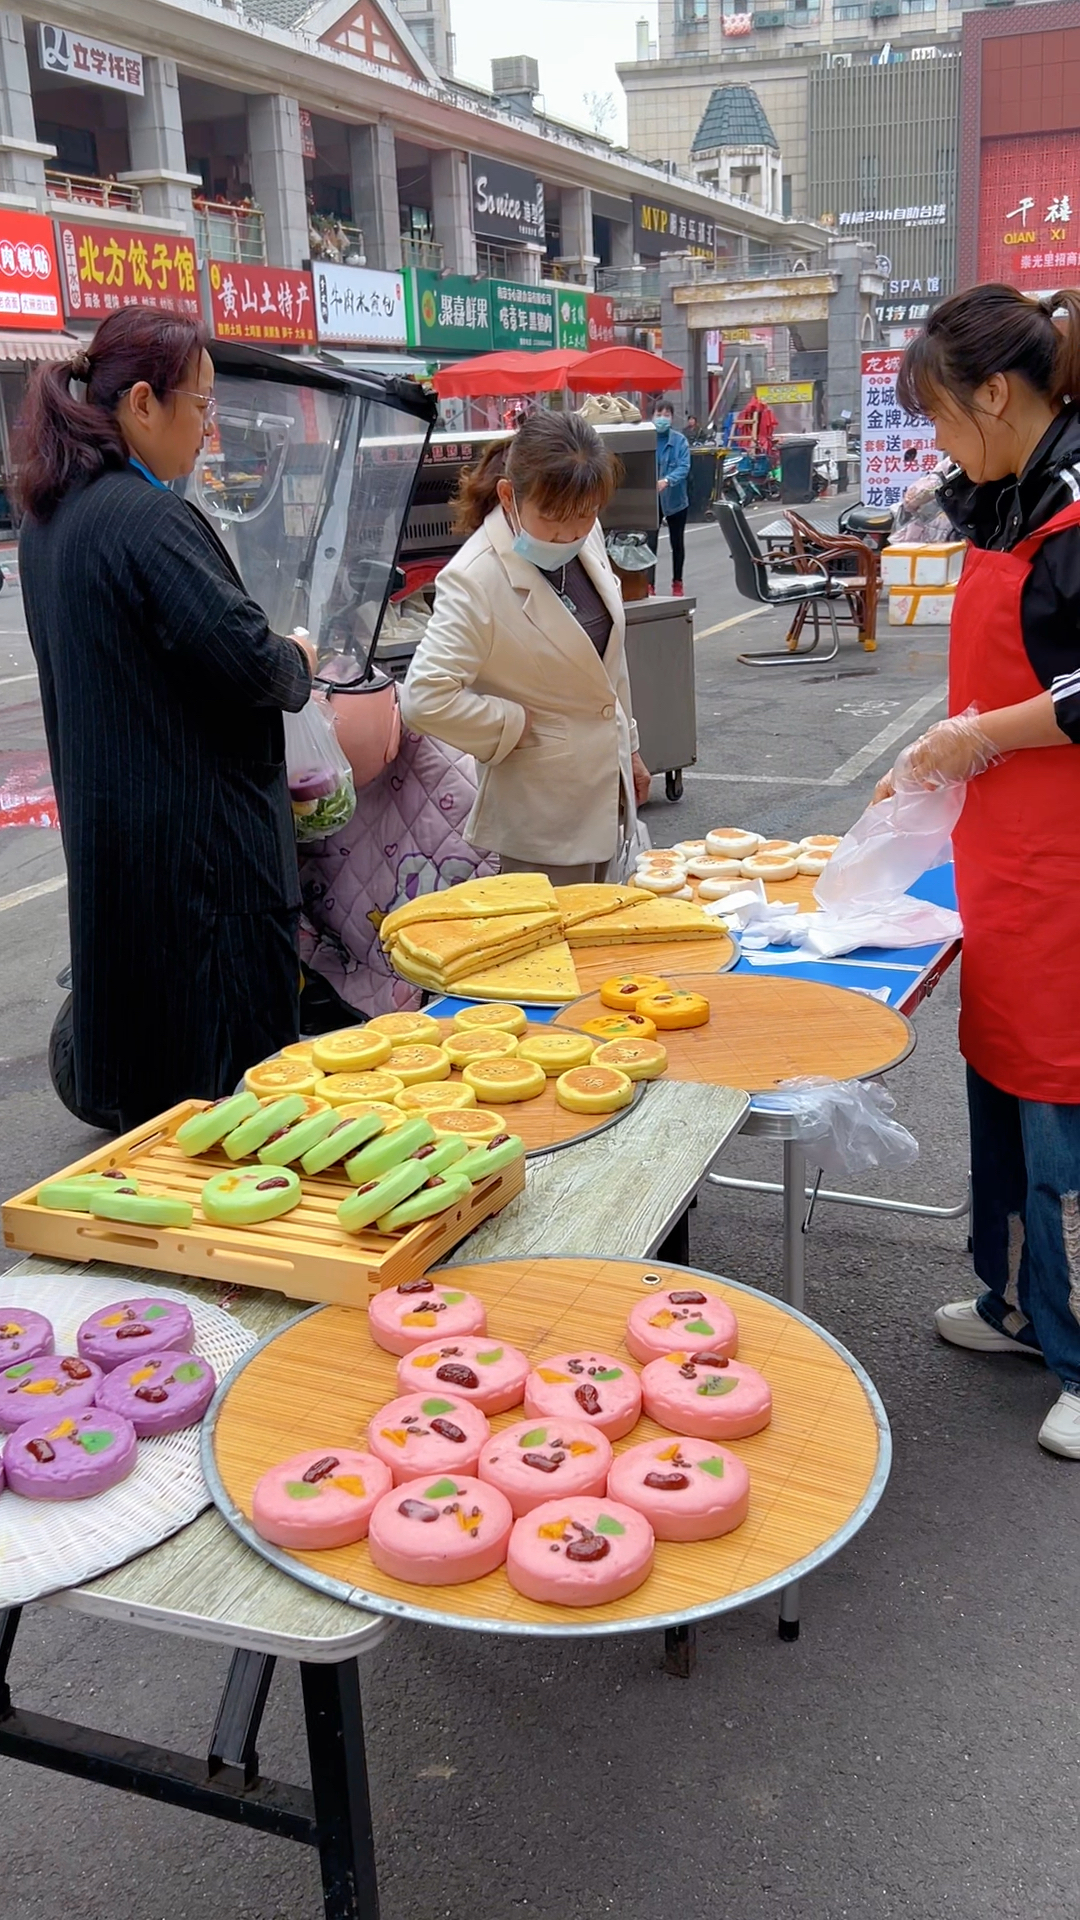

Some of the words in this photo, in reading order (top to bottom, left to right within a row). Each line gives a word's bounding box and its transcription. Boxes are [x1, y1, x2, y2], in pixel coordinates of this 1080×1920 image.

[72, 41, 140, 86] 立学托管
[641, 205, 668, 233] MVP
[1003, 231, 1035, 245] QIAN
[1050, 228, 1066, 241] XI
[0, 244, 48, 274] 肉锅贴
[64, 234, 80, 304] 手工水饺
[79, 235, 196, 292] 北方饺子馆
[1020, 251, 1080, 269] 崇光里招商
[890, 278, 922, 293] SPA
[926, 277, 940, 292] 馆
[218, 273, 310, 323] 黄山土特产
[438, 294, 488, 329] 聚嘉鲜果
[875, 303, 930, 322] 特健
[866, 356, 901, 372] 龙城
[866, 387, 897, 407] 龙城
[867, 408, 935, 429] 金牌龙虾
[866, 454, 938, 473] 冷饮免费
[866, 487, 902, 507] 龙蟹
